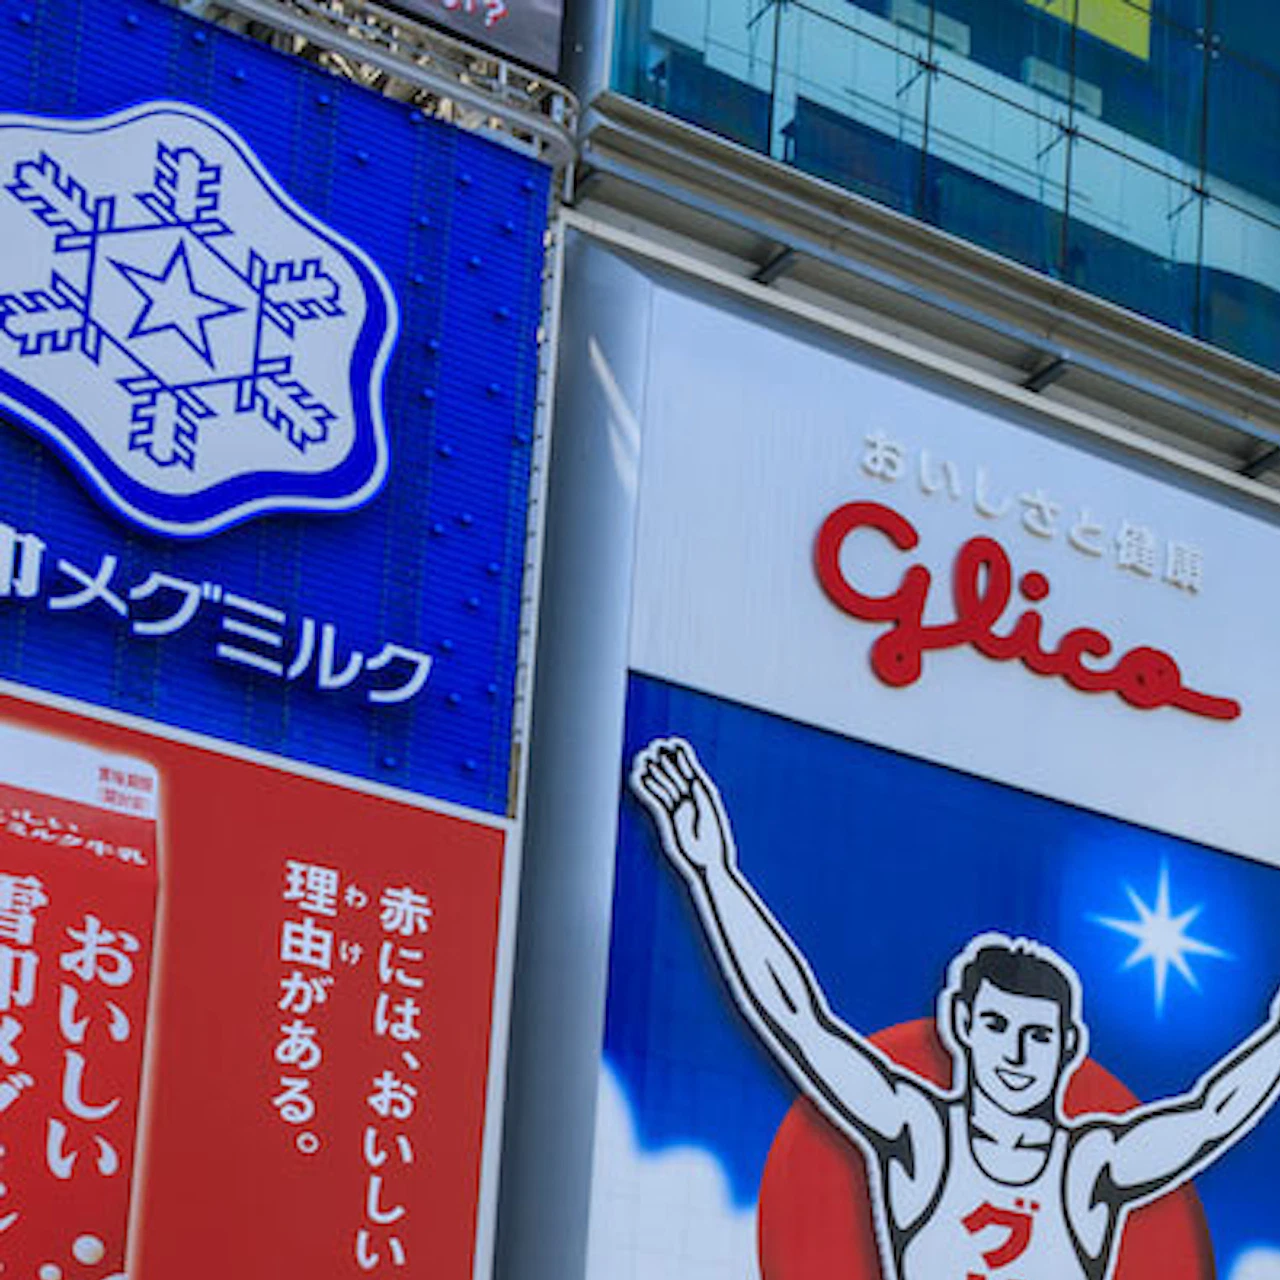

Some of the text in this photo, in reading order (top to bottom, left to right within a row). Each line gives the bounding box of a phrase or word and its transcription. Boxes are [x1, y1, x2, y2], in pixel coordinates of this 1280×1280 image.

[813, 499, 1242, 721] Glico
[47, 913, 141, 1179] おいしい
[272, 859, 339, 1156] 理由がある。
[354, 885, 434, 1271] 赤には、おいしい
